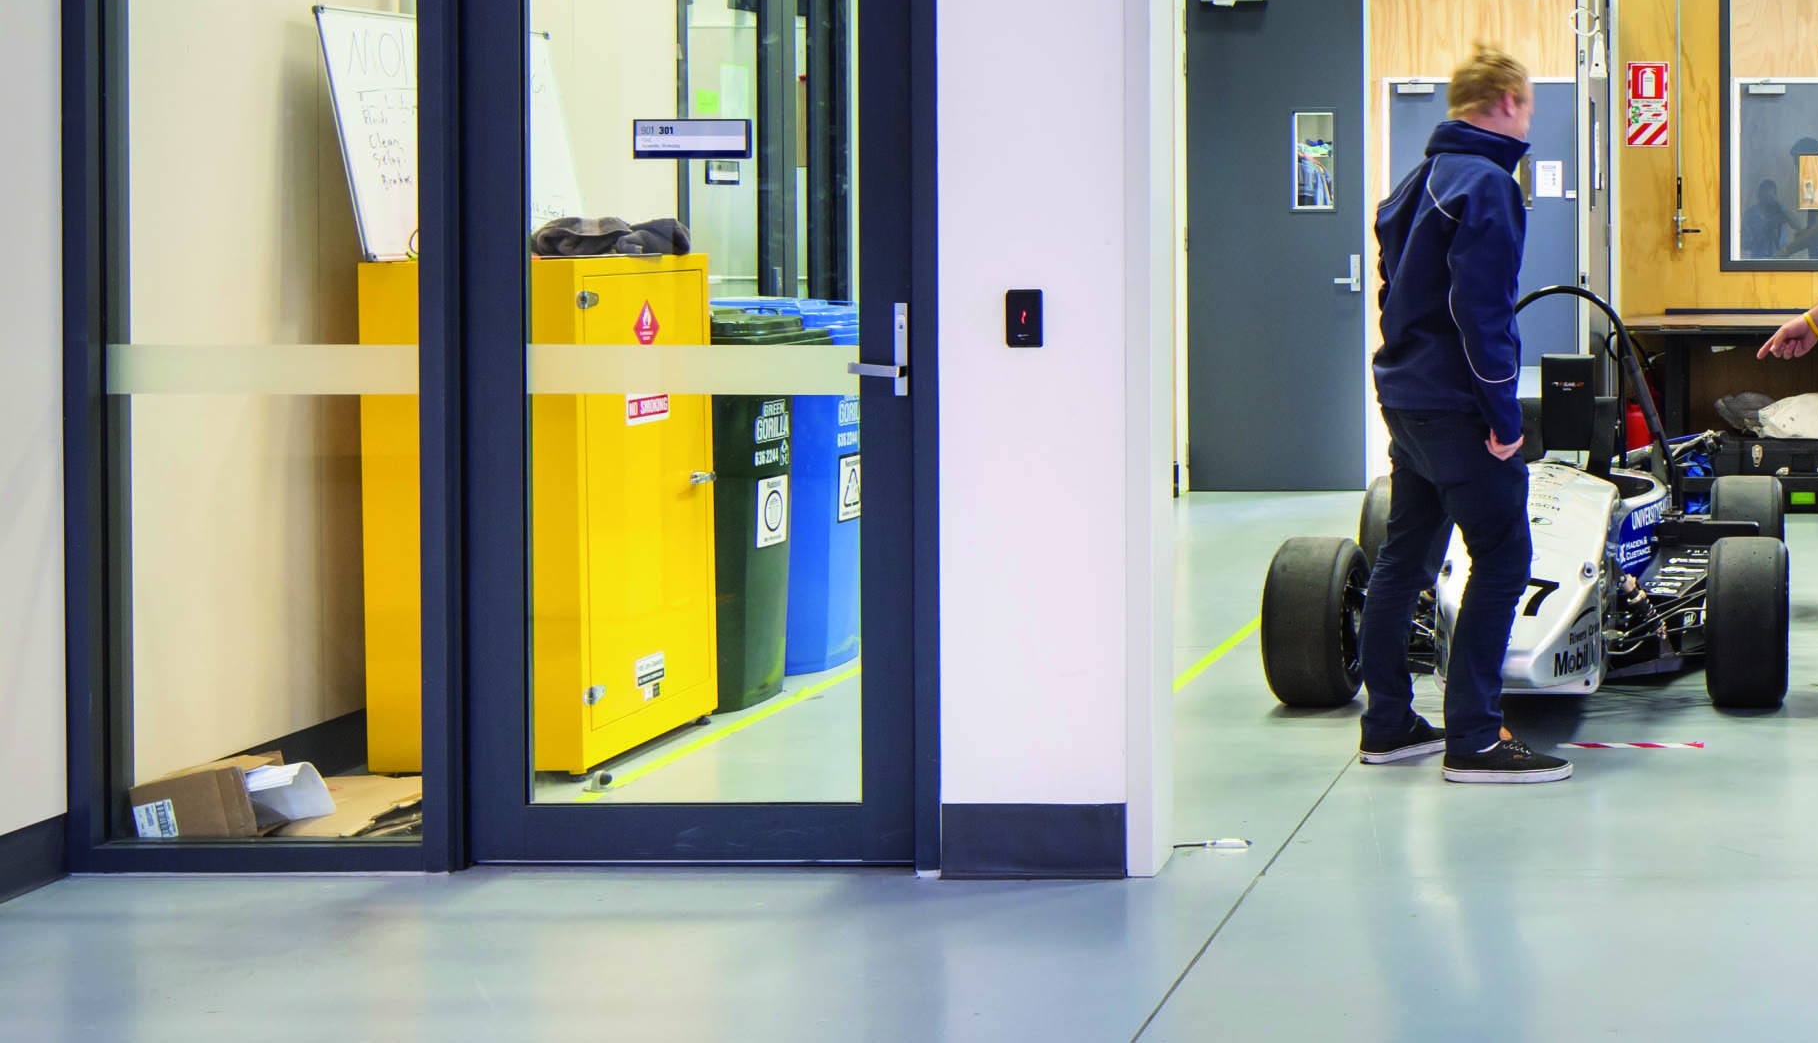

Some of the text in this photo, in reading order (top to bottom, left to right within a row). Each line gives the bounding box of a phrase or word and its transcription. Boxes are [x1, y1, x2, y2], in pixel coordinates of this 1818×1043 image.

[658, 125, 674, 135] 301
[628, 396, 669, 418] NO SMOKING
[763, 399, 786, 417] GREEN
[756, 412, 790, 443] GORILLA
[1553, 644, 1589, 678] Mobil
